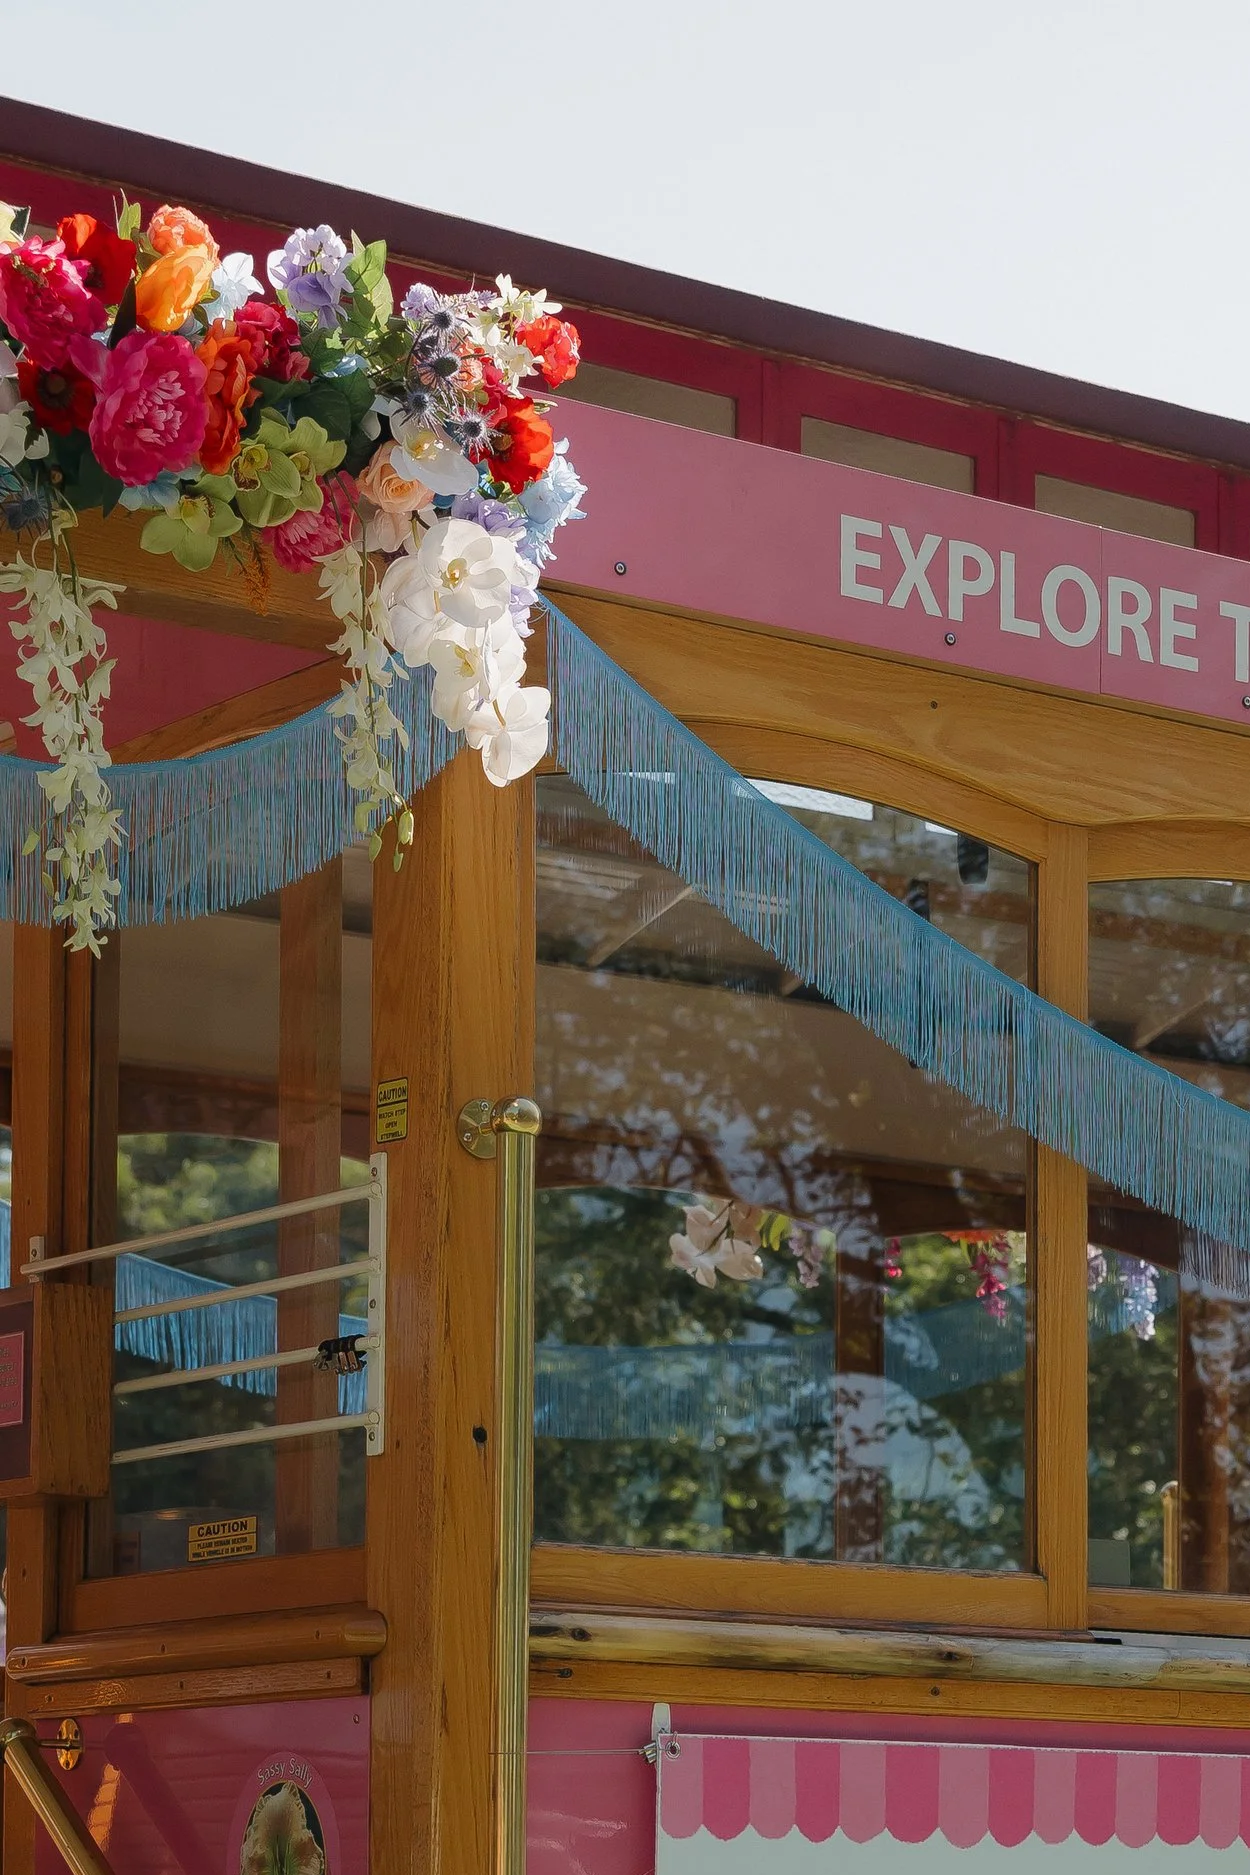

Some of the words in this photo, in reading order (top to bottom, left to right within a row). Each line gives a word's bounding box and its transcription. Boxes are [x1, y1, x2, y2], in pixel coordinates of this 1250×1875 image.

[839, 513, 1200, 673] EXPLORE
[378, 1085, 407, 1102] CAUTION
[197, 1520, 248, 1538] CAUTION
[257, 1762, 286, 1786] Sassy
[289, 1757, 313, 1788] Sally
